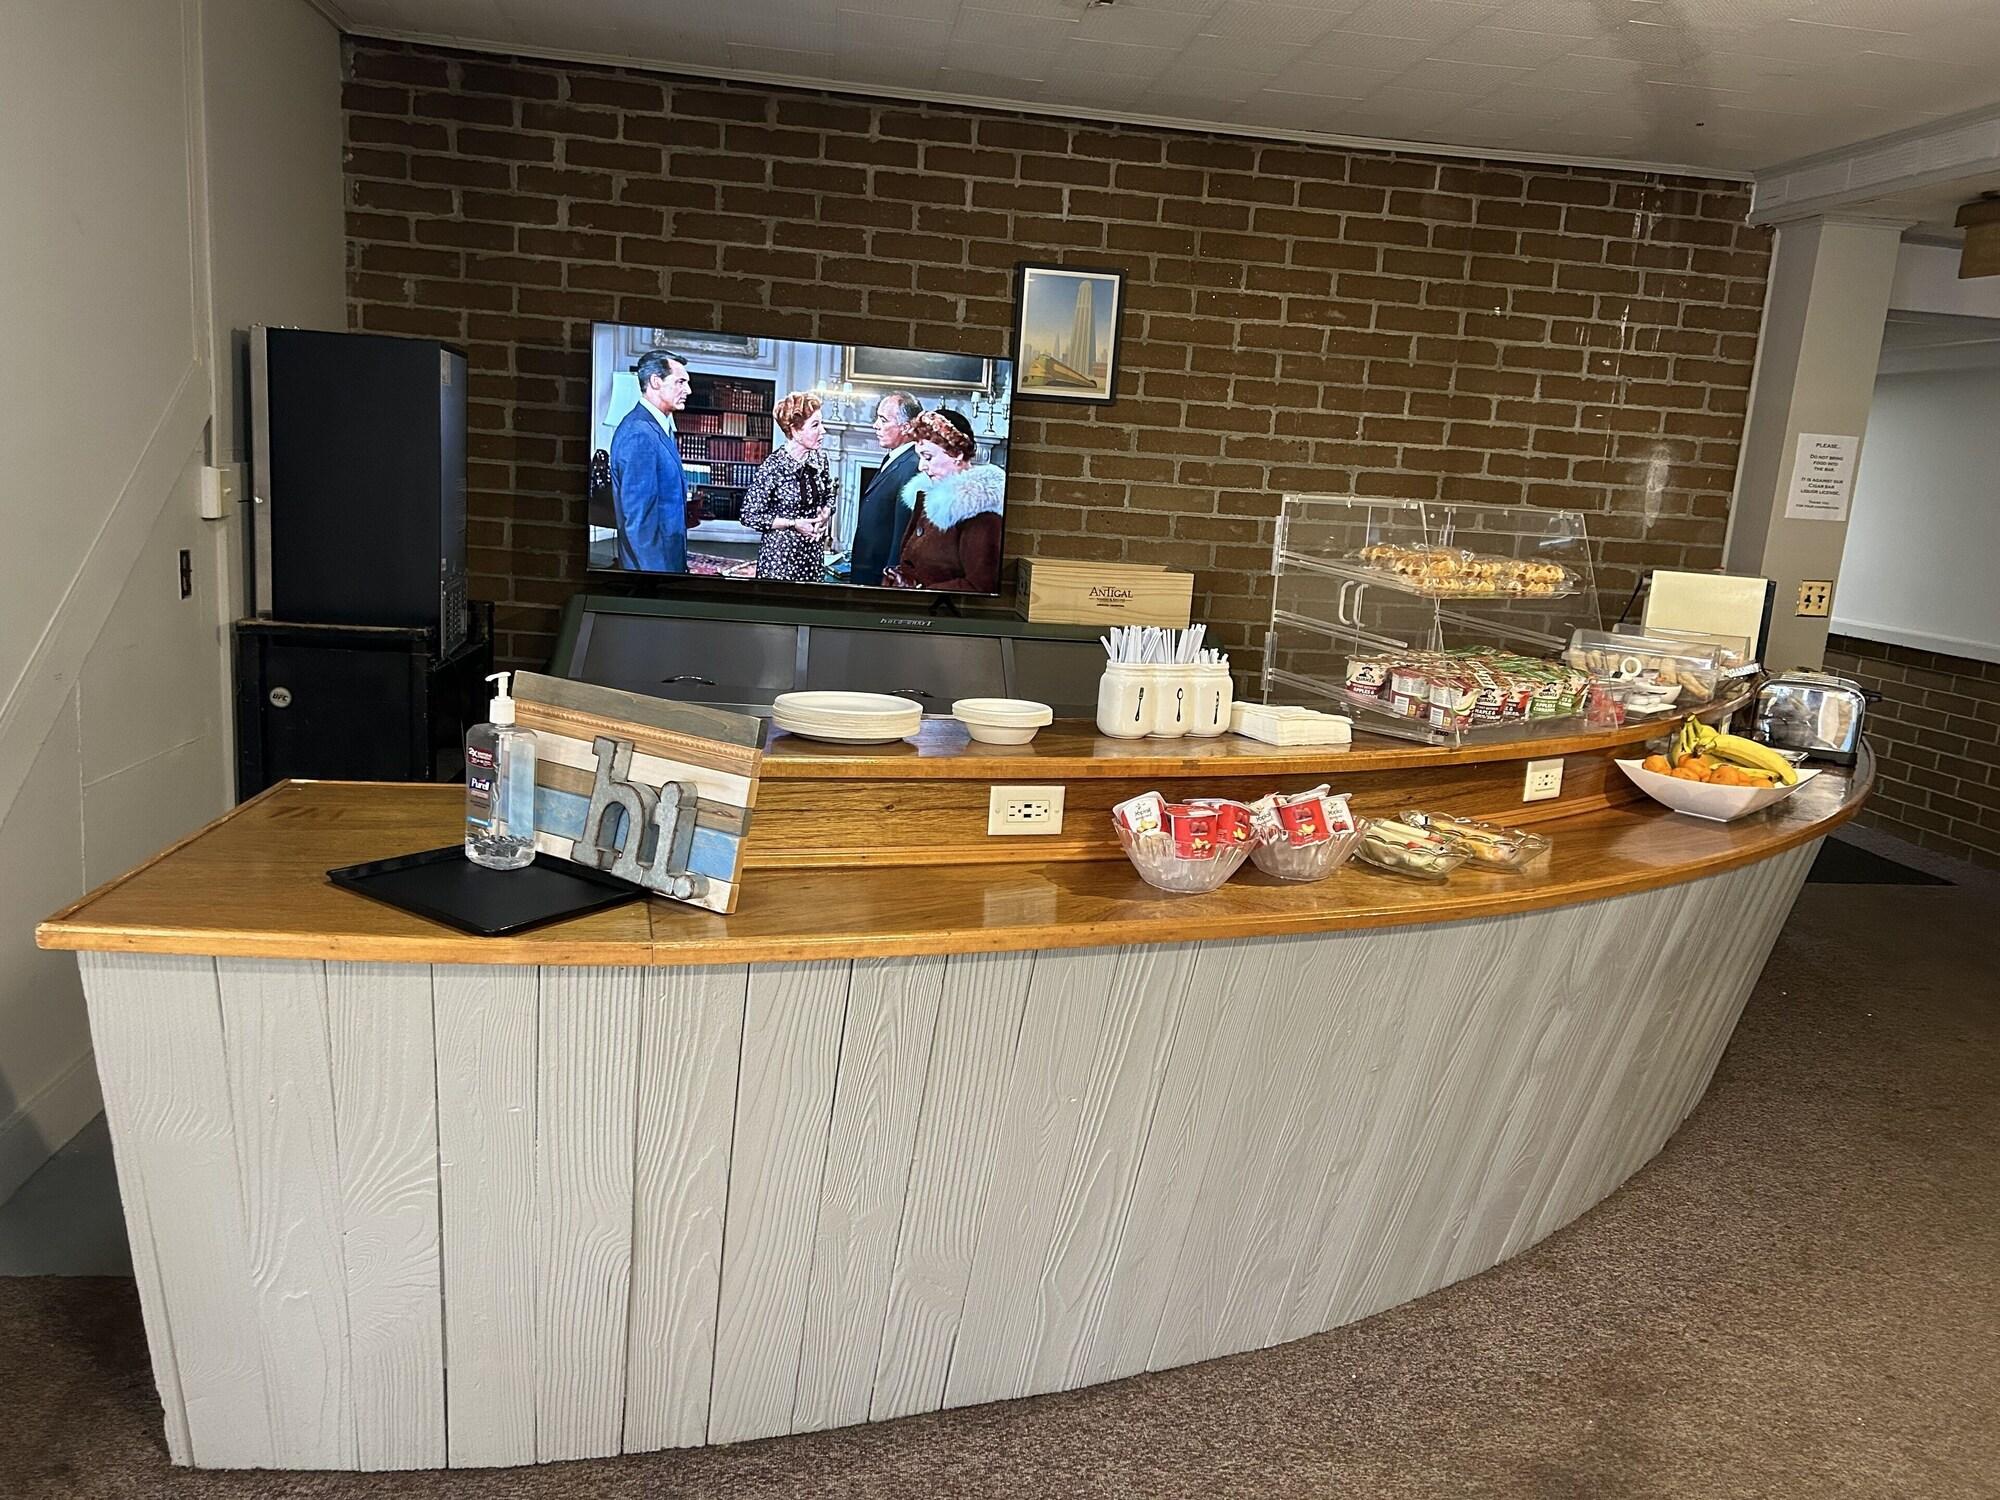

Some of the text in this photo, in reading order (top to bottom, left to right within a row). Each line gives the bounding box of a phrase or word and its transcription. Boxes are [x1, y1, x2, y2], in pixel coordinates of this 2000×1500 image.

[1088, 585, 1134, 598] ANTIGAL
[1352, 687, 1372, 695] APPLES
[471, 777, 490, 791] Purell
